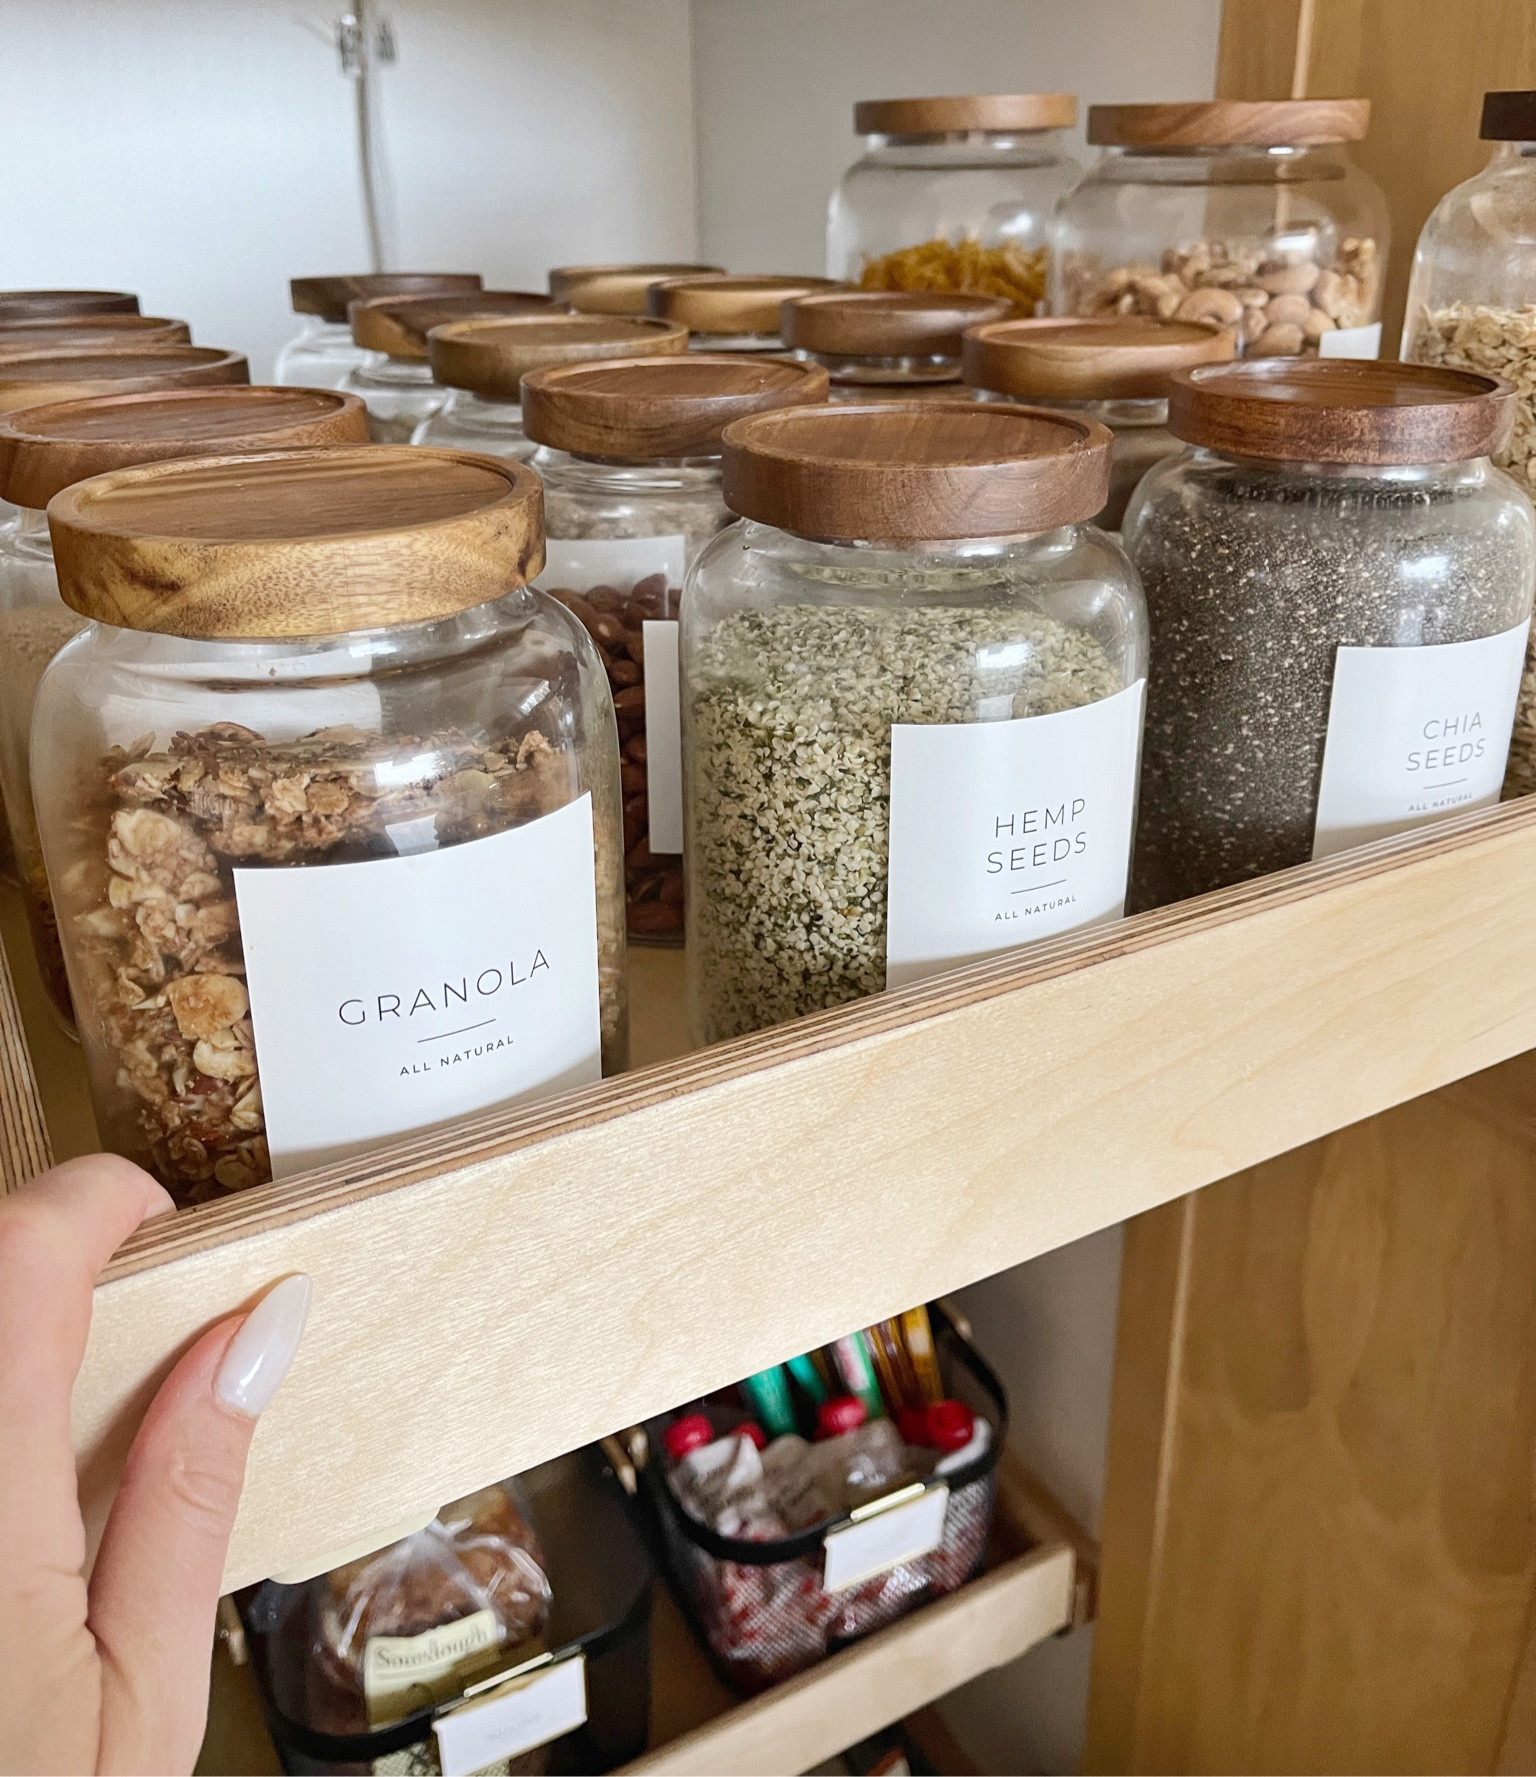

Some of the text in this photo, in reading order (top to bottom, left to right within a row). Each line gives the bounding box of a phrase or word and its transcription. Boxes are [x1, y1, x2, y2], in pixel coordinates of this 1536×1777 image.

[1423, 712, 1482, 739] CHIA
[1406, 738, 1486, 771] SEEDS
[995, 798, 1086, 838] HEMP
[1408, 792, 1473, 812] ALL NATURAL
[986, 831, 1087, 874] SEEDS
[994, 895, 1077, 921] ALL NATURAL
[338, 949, 550, 1025] GRANOLA
[399, 1035, 514, 1076] ALL NATURAL
